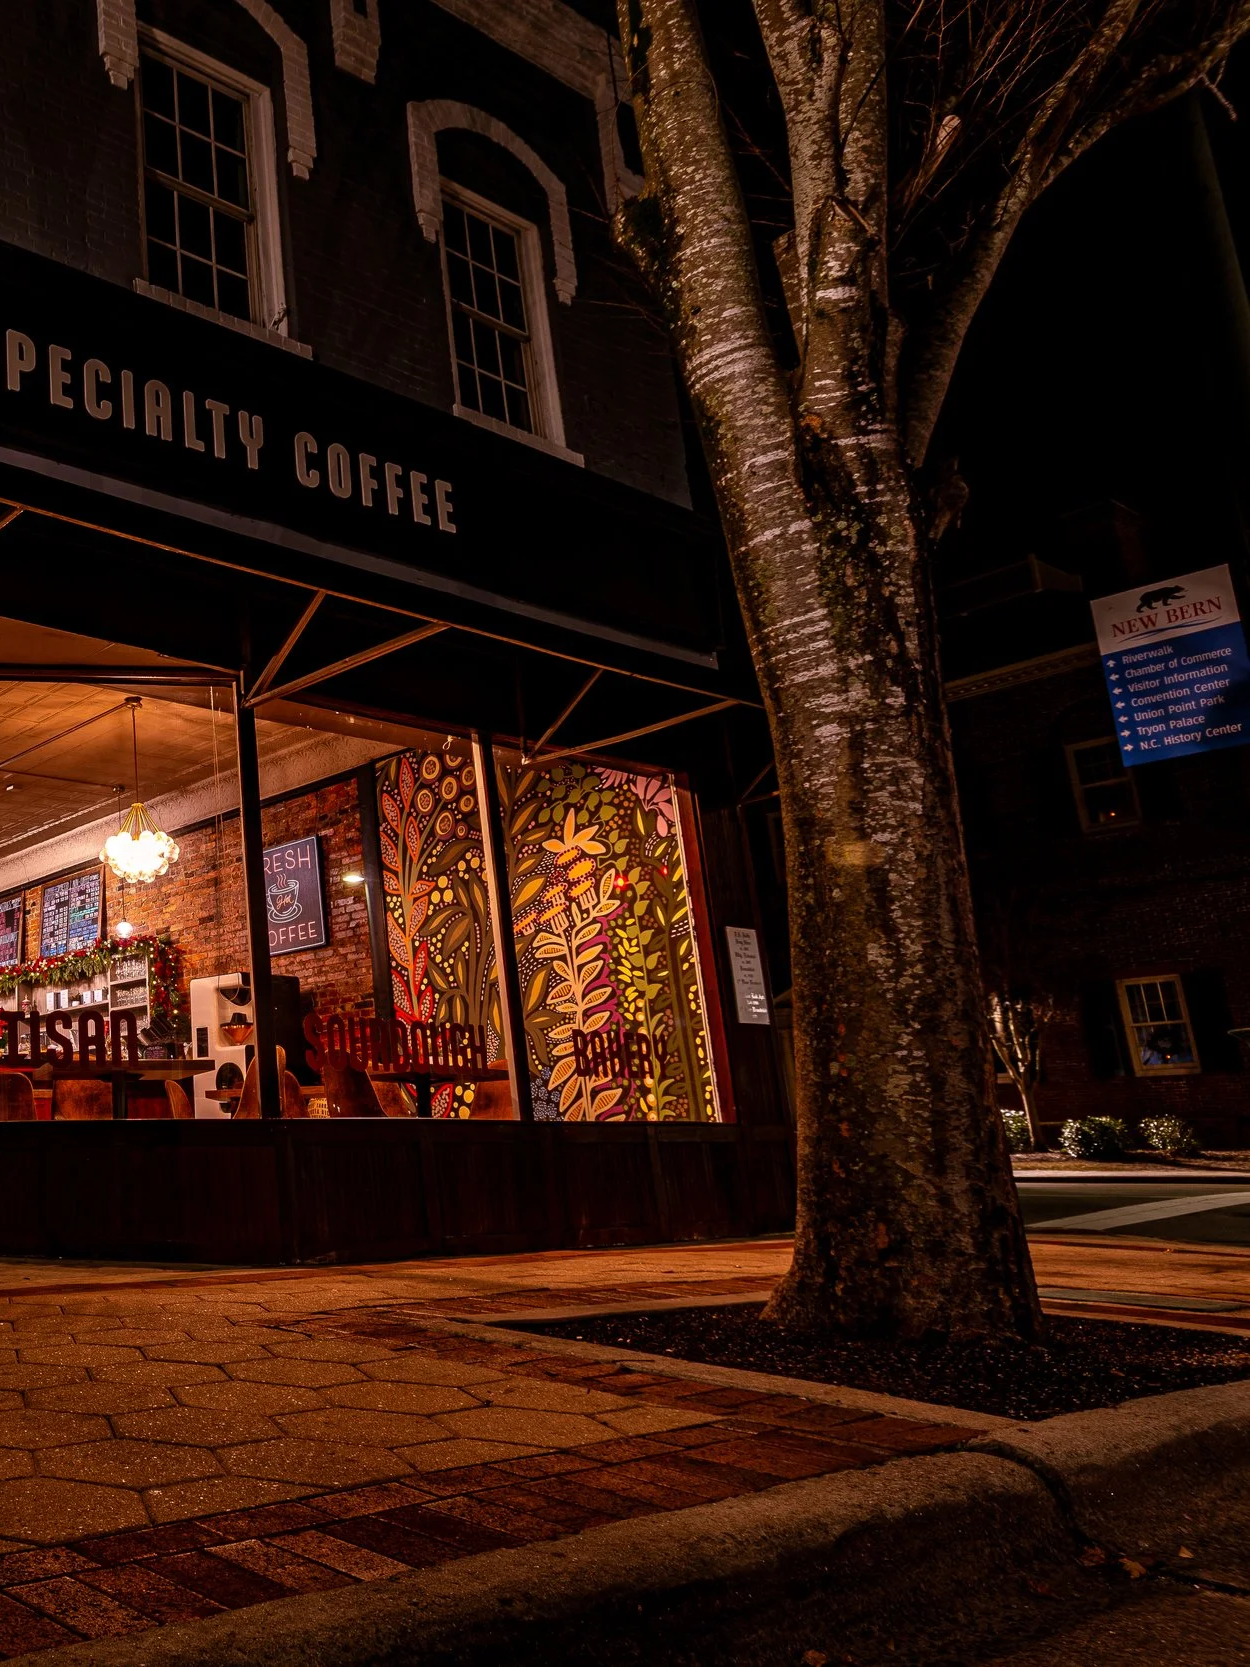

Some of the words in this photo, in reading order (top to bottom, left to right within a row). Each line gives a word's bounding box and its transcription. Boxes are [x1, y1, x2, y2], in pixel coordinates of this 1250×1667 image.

[293, 431, 458, 534] COFFEE
[1110, 613, 1158, 638] NEW
[1166, 596, 1223, 624] BERN
[1122, 645, 1174, 665] Riverwalk
[1125, 661, 1165, 679] Chamber
[1168, 658, 1178, 669] of
[1181, 647, 1232, 666] Commerce
[1127, 677, 1161, 693] Visitor
[1164, 663, 1228, 685] Information
[1131, 687, 1190, 707] Convention
[1194, 677, 1231, 694] Center
[1133, 706, 1165, 722] Union
[1168, 700, 1196, 715] Point
[1200, 694, 1226, 708] Park
[1136, 723, 1166, 738] Tryon
[1169, 714, 1206, 730] Palace
[1139, 738, 1162, 751] N.C.
[1164, 730, 1202, 747] History
[1205, 722, 1243, 738] Center
[263, 844, 311, 874] RESH
[268, 920, 318, 947] OFFEE
[303, 1014, 488, 1074] SOURDOUGH
[571, 1028, 669, 1080] BAKERY
